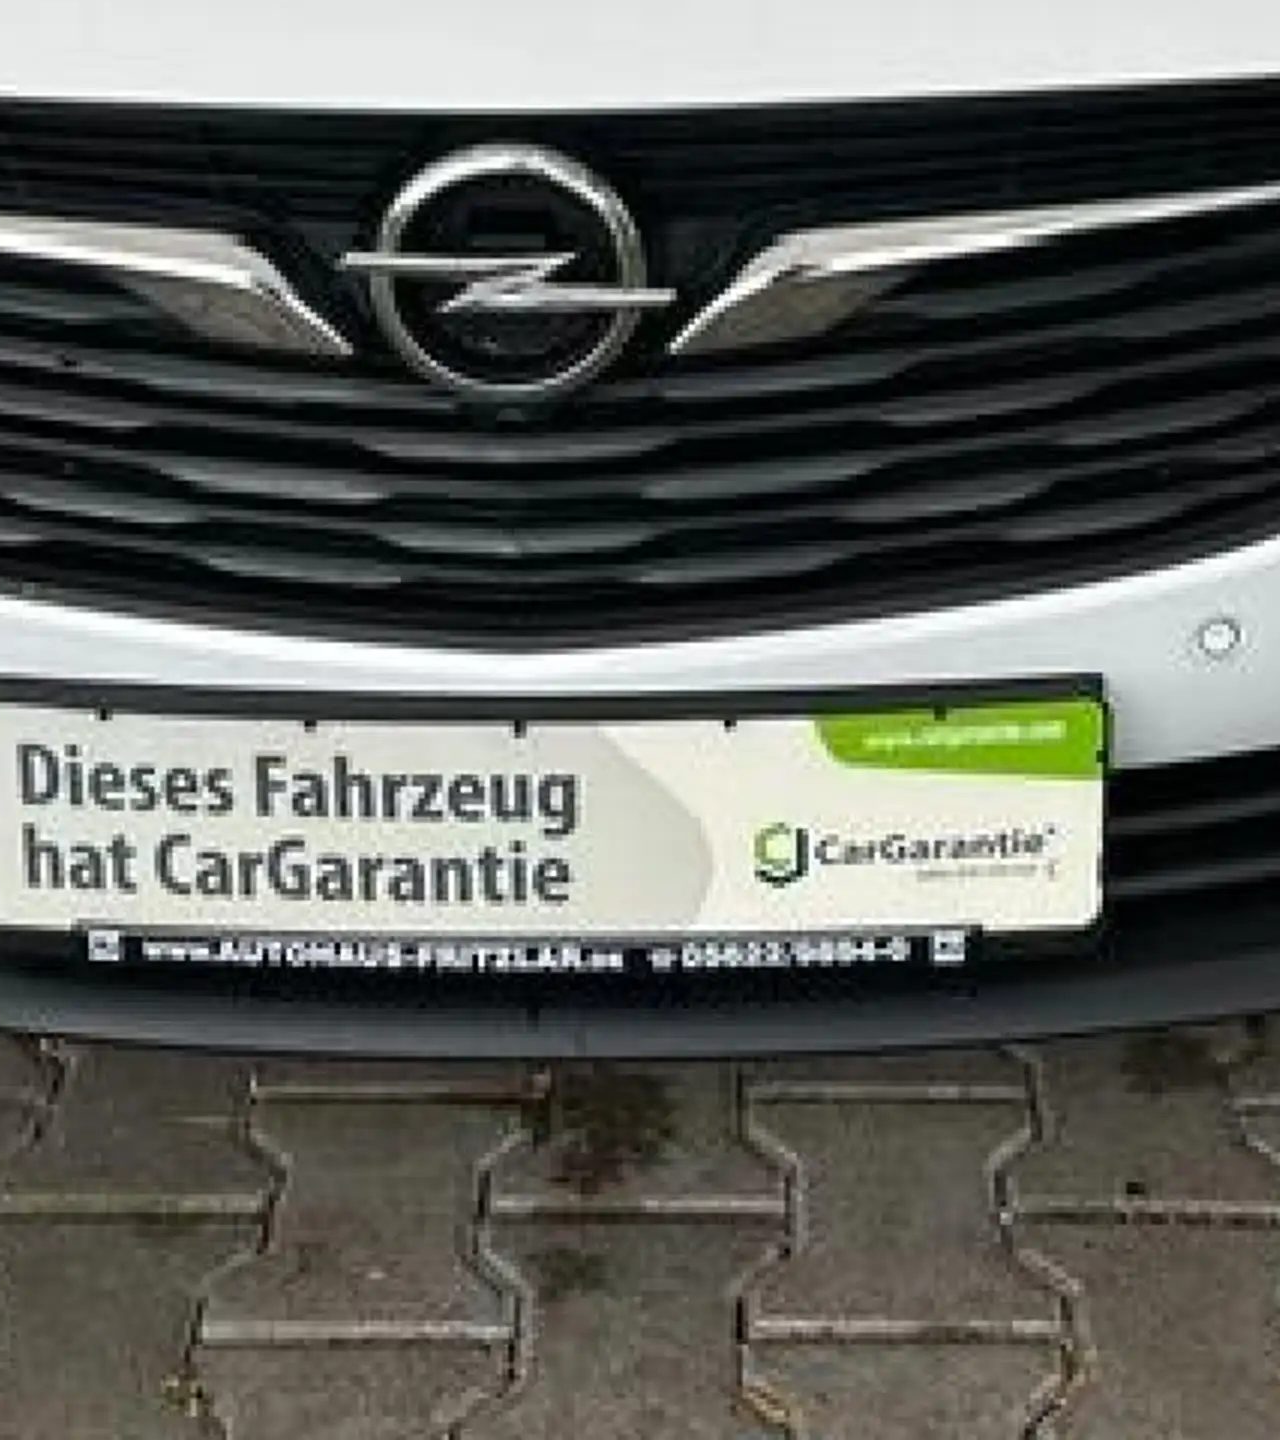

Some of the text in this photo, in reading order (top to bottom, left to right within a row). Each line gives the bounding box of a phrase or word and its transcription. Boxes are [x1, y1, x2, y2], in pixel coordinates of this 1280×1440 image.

[16, 743, 578, 835] Dieses Fahrzeug
[21, 822, 572, 903] hat CarGarantie
